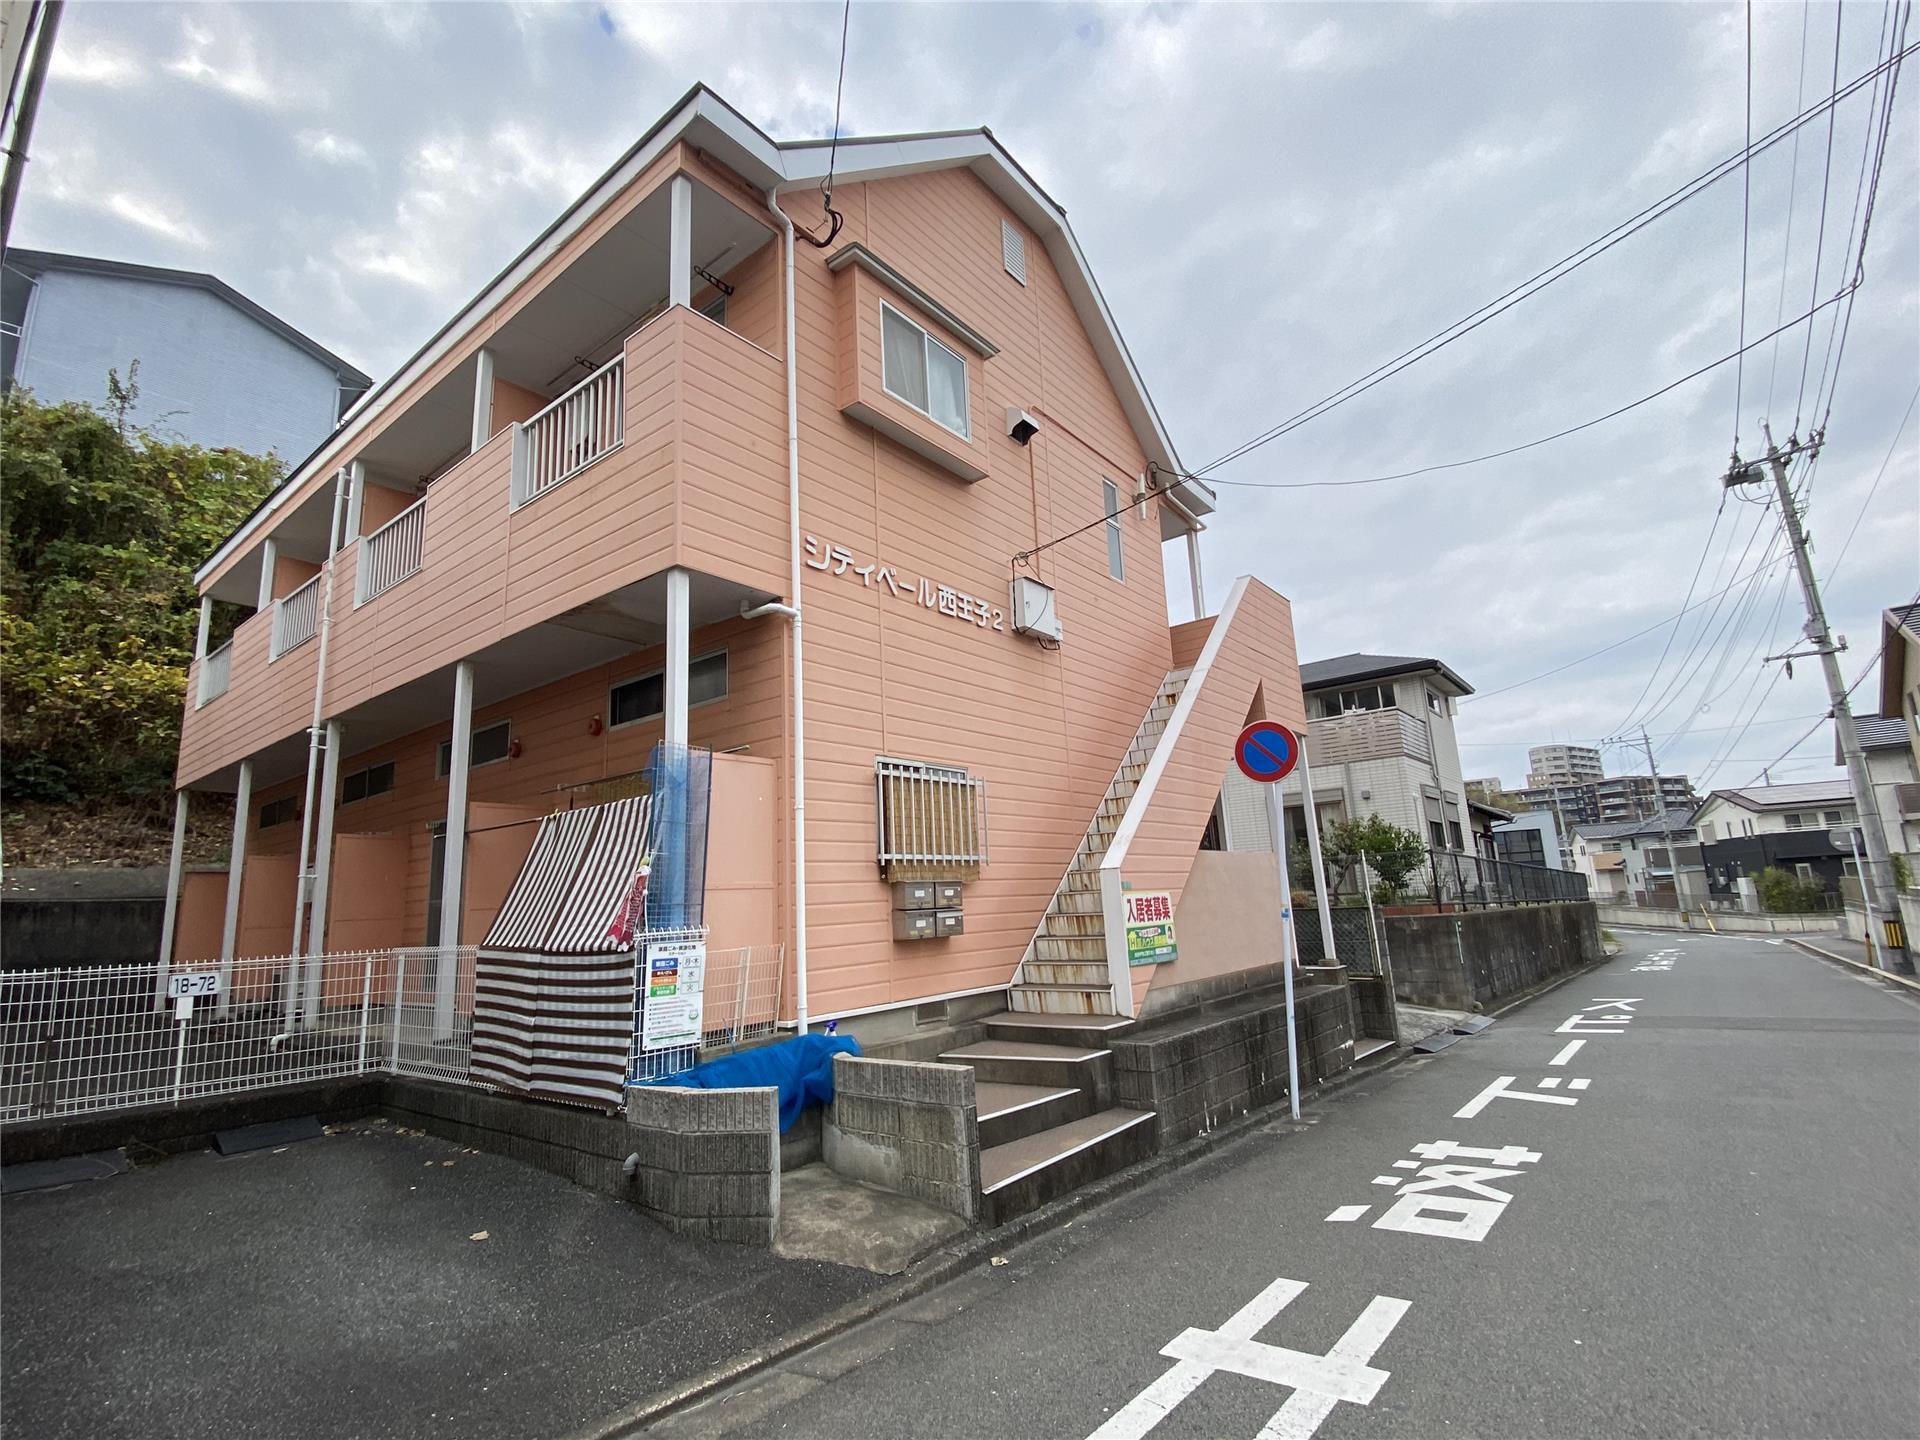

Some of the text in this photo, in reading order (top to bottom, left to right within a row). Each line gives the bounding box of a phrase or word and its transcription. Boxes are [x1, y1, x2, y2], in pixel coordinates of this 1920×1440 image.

[805, 535, 1004, 631] シティベール西王子2
[1126, 896, 1171, 923] 入居者募集
[174, 976, 216, 994] 18-72
